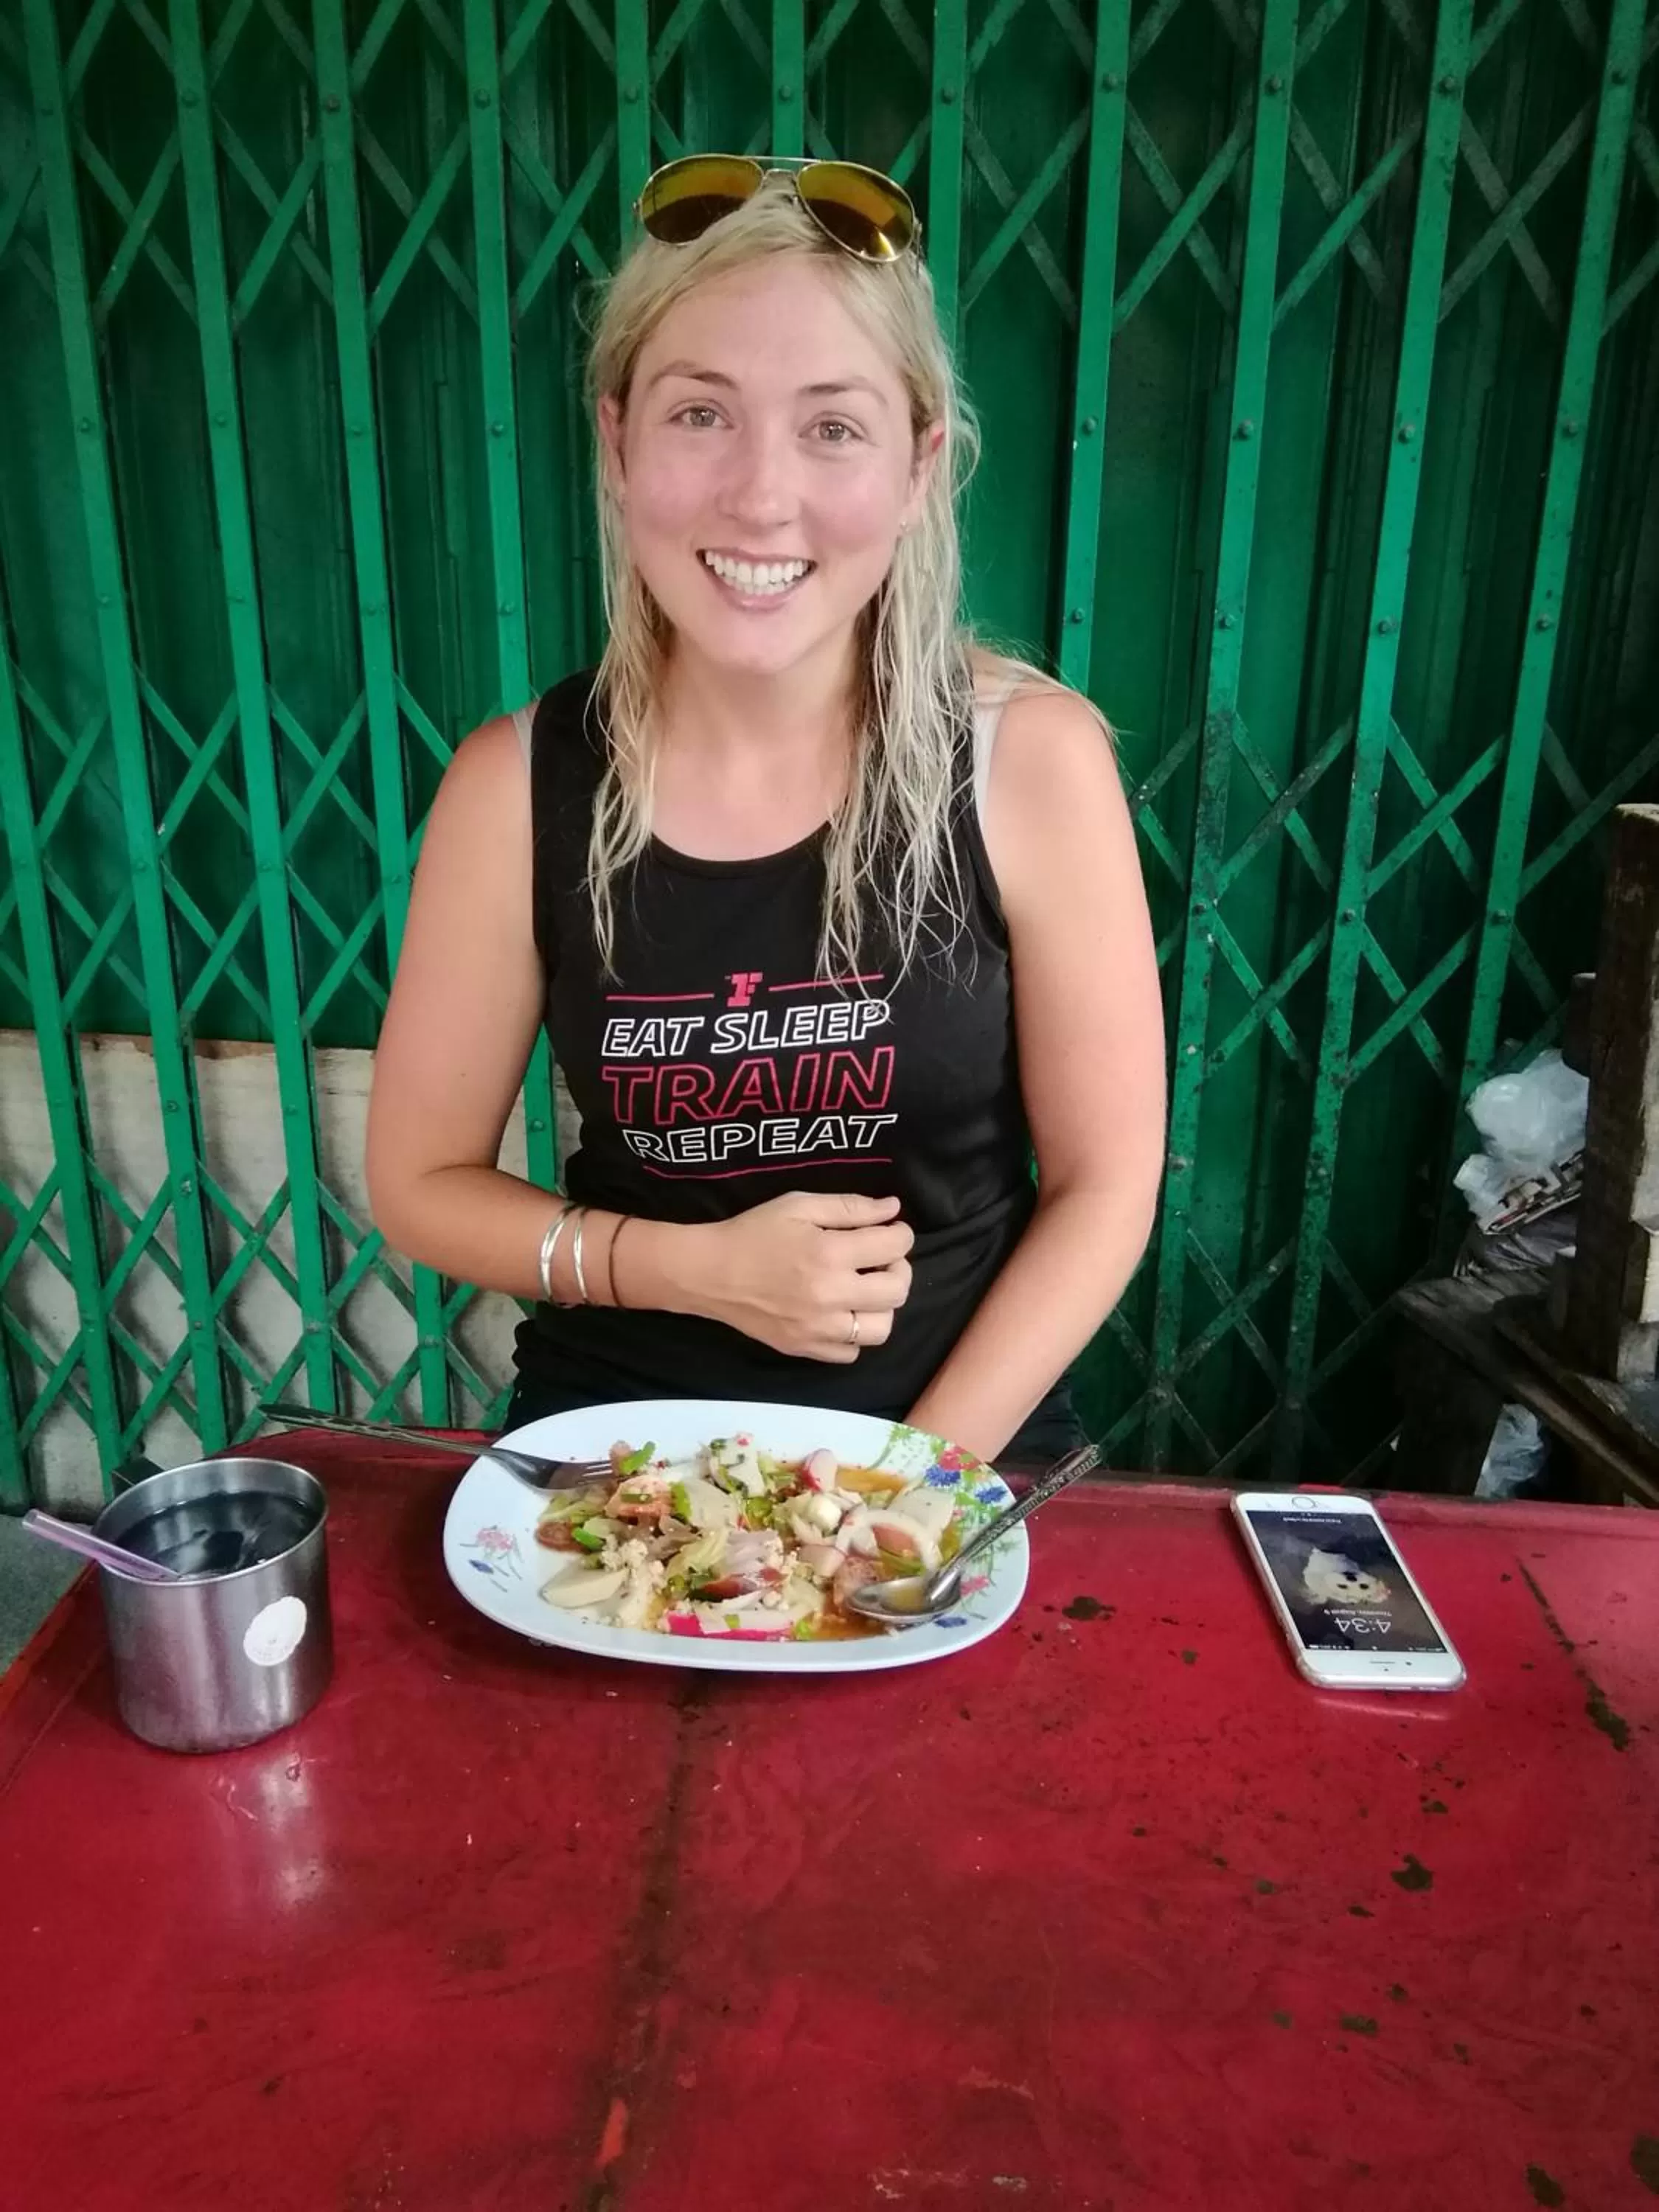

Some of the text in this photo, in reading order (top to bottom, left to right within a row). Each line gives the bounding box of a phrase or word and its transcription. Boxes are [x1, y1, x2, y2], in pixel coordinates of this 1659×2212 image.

[602, 999, 890, 1057] EAT SLEEP
[602, 1046, 895, 1125] TRAIN
[622, 1114, 898, 1163] REPEAT
[1335, 1618, 1391, 1633] 4:34
